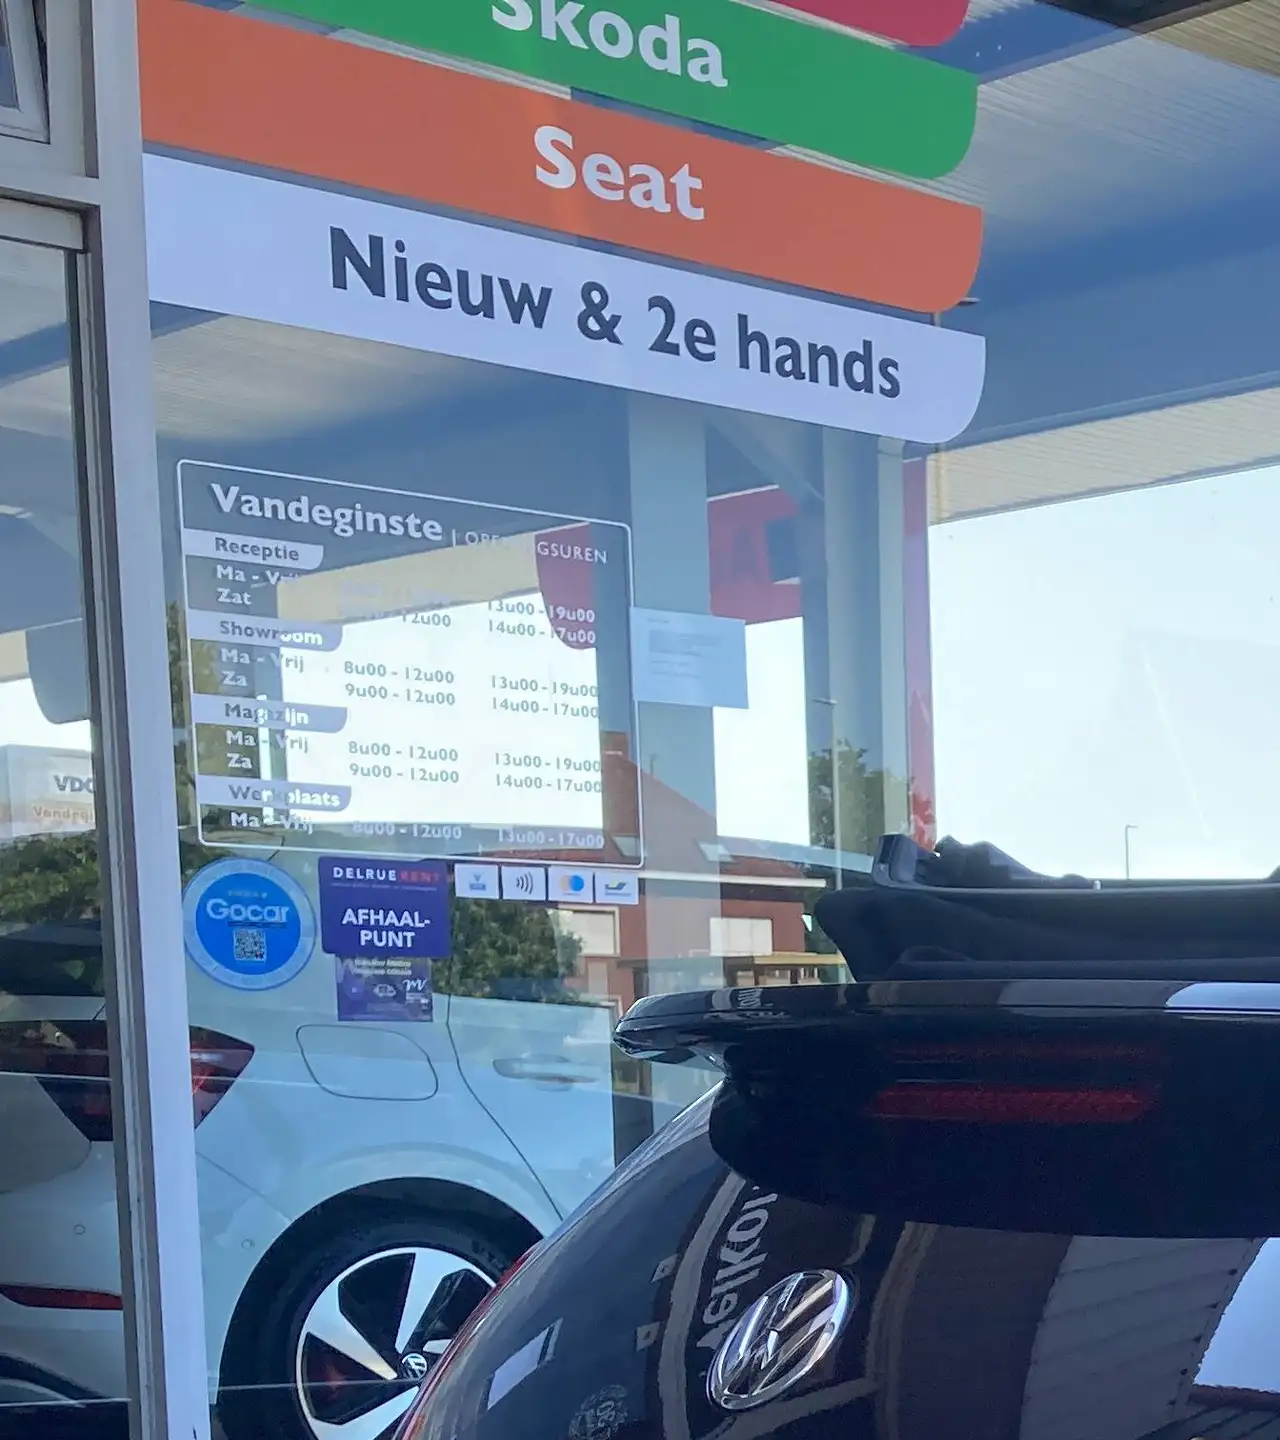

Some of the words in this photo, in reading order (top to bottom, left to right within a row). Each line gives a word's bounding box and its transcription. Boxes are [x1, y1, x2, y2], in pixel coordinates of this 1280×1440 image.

[533, 124, 705, 222] Seat
[328, 226, 554, 330] Nieuw
[575, 281, 624, 345] &
[647, 295, 718, 364] 2e
[737, 314, 903, 400] hands
[211, 482, 444, 540] Vandeginste
[214, 537, 300, 561] Receptie
[215, 587, 252, 605] Zat
[488, 620, 536, 637] 14u00
[216, 564, 247, 582] Ma
[549, 607, 596, 623] 19u00
[219, 620, 324, 646] Showroom
[220, 648, 251, 664] Ma
[344, 661, 387, 677] 8u00
[404, 666, 455, 684] 12u00
[491, 675, 539, 692] 13u00
[552, 681, 599, 698] 19u00
[221, 670, 249, 687] Za
[345, 683, 388, 699] 9u00
[406, 688, 456, 706] 12u00
[492, 697, 539, 714] 14u00
[553, 703, 600, 719] 17u00
[225, 730, 257, 746] Ma
[348, 741, 391, 757] 8u00
[409, 745, 459, 762] 12u00
[495, 752, 542, 769] 13u00
[555, 757, 602, 773] 19u00
[226, 752, 253, 769] Za
[349, 763, 392, 779] 9u00
[410, 767, 460, 784] 12u00
[495, 773, 543, 789] 14u00
[556, 778, 602, 793] 17u00
[228, 784, 341, 807] Werplaats
[230, 812, 261, 828] Ma
[351, 821, 396, 836] 8u00
[412, 825, 463, 840] 12u00
[498, 828, 546, 845] 13u00
[558, 832, 605, 848] 17u00
[333, 866, 397, 881] DELRUE
[206, 898, 290, 922] Gocar
[342, 908, 431, 928] AFHAAL-
[360, 929, 416, 948] PUNT
